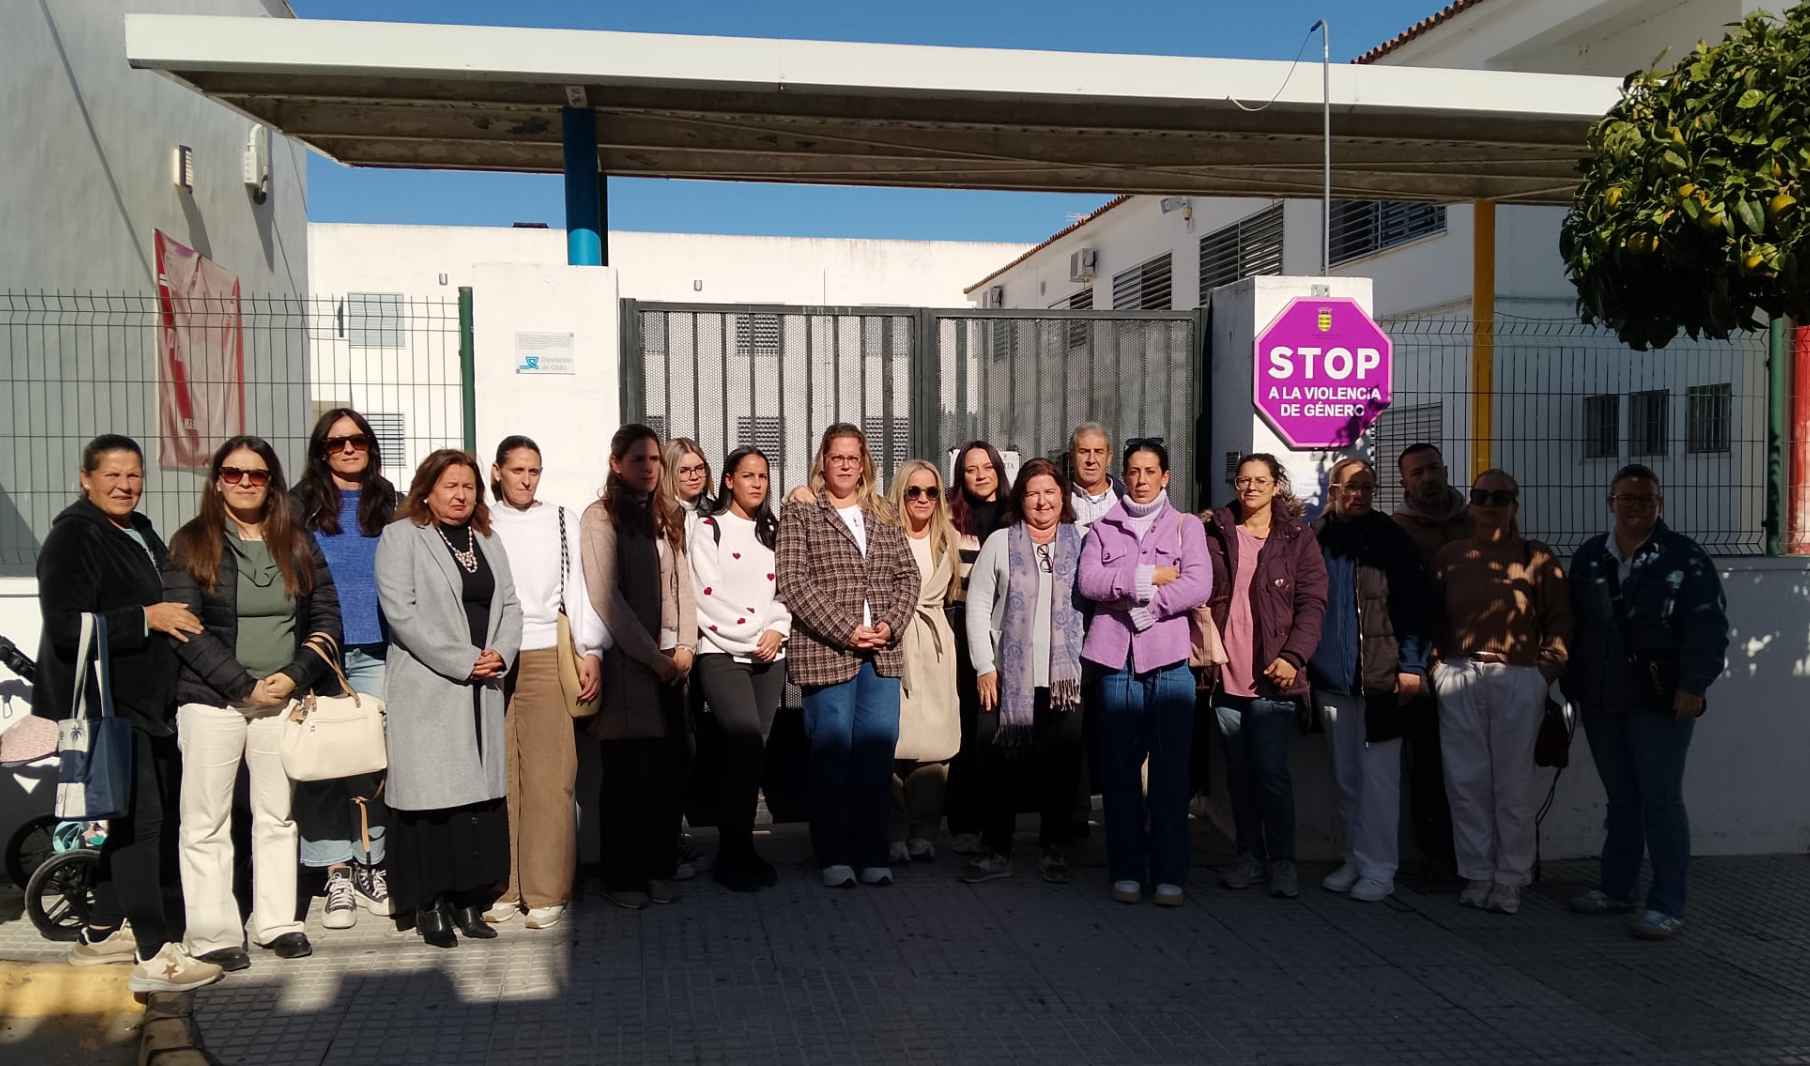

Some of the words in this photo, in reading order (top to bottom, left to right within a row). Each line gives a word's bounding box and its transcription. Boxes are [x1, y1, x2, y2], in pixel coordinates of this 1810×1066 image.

[1268, 346, 1380, 380] STOP
[1268, 386, 1280, 400] A
[1282, 386, 1302, 400] LA
[1304, 387, 1382, 400] VIOLENCIA
[1280, 404, 1301, 417] DE
[1304, 401, 1365, 417] GÉNERO
